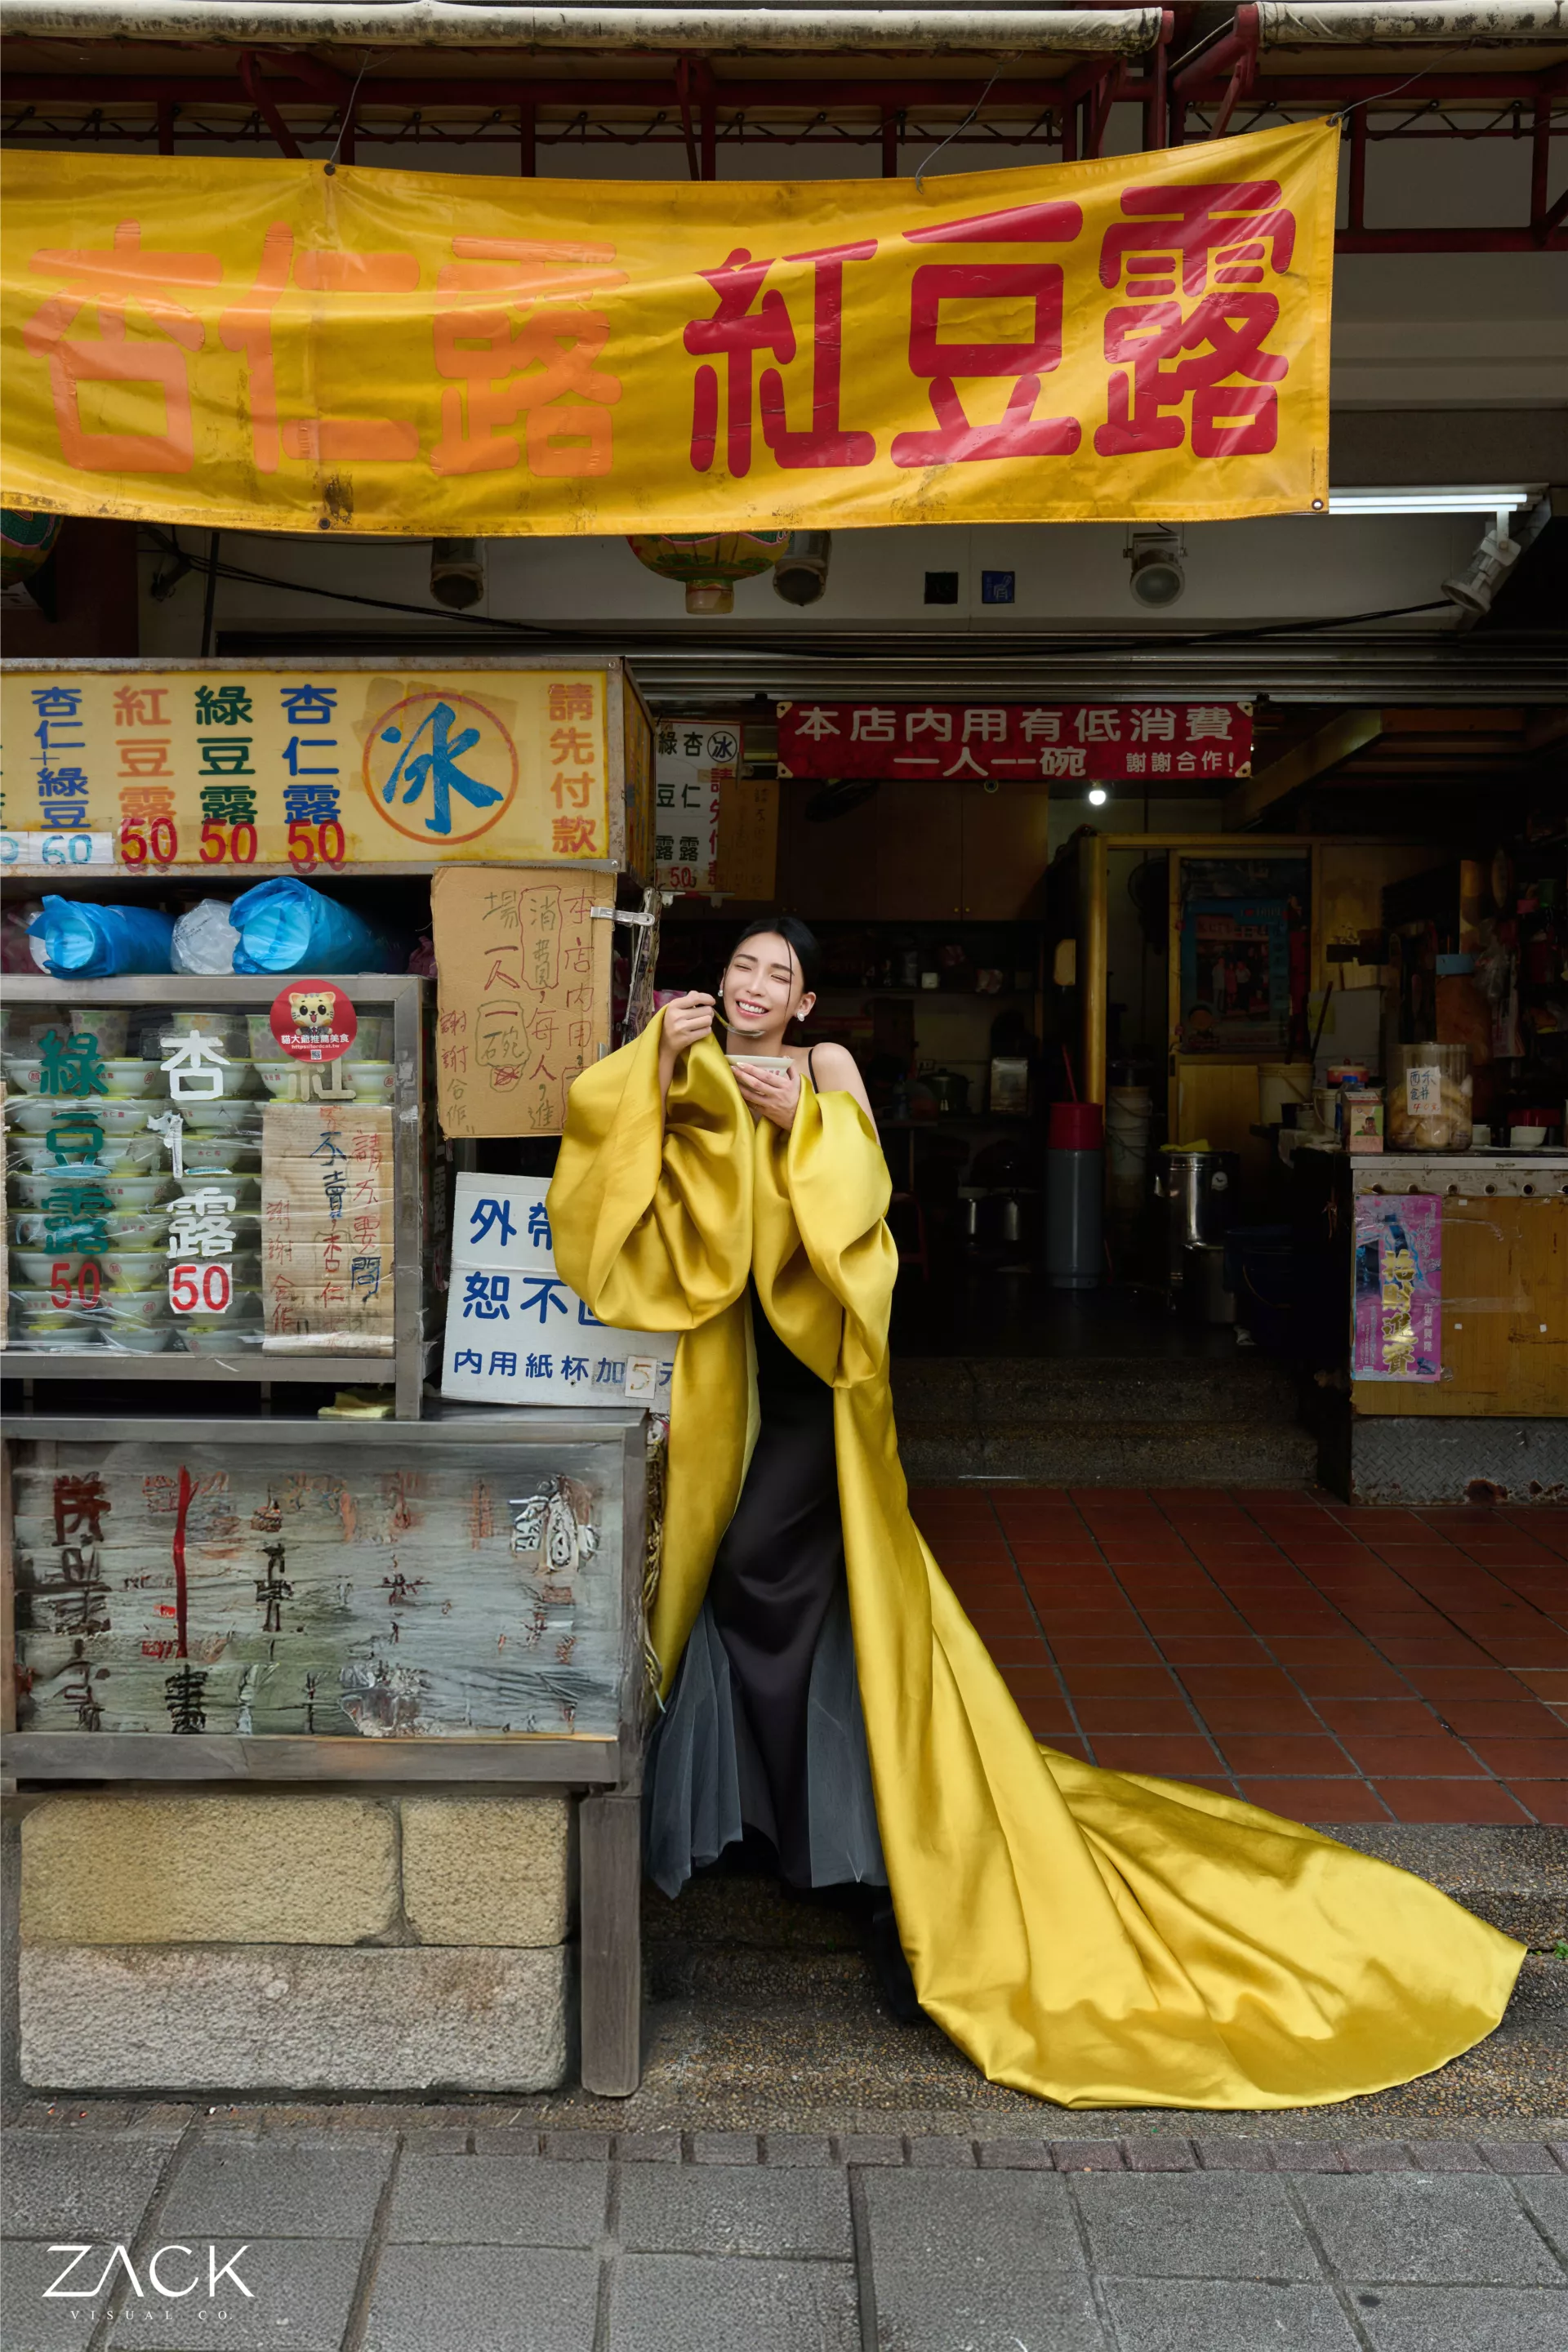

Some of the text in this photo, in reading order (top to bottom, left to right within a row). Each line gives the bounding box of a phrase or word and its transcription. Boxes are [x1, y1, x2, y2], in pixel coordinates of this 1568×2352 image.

[683, 180, 1297, 478] 紅豆露
[194, 685, 258, 826] 綠豆露
[280, 684, 341, 825] 杏仁露
[380, 702, 505, 835] 冰
[548, 684, 599, 855] 請先付款
[795, 707, 1234, 742] 本店內用有低消費
[893, 747, 1088, 777] 一人一碗
[120, 817, 178, 866] 50
[199, 818, 258, 863] 50
[288, 819, 346, 867] 50
[656, 731, 678, 862] 綠豆露
[679, 733, 704, 862] 杏仁露
[39, 1030, 114, 1256] 綠豆露
[51, 1263, 100, 1309] 50
[172, 1265, 229, 1311] 50
